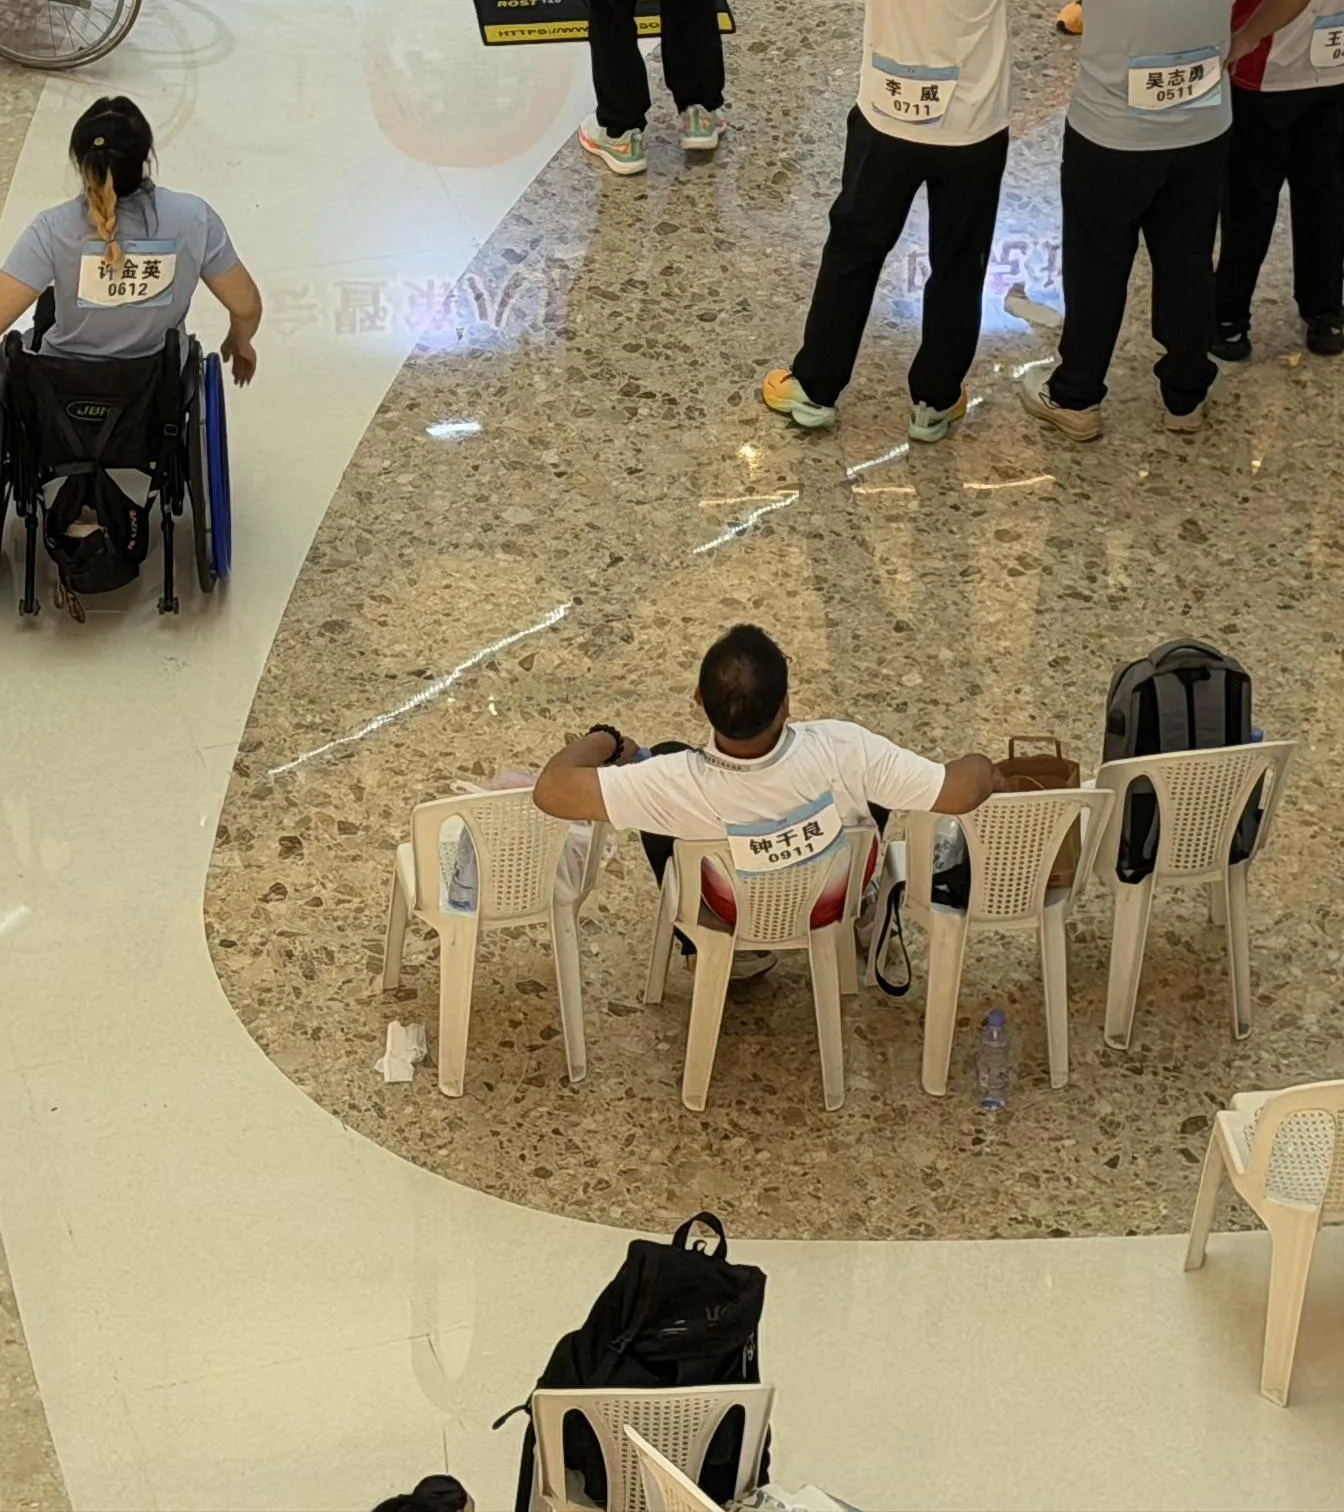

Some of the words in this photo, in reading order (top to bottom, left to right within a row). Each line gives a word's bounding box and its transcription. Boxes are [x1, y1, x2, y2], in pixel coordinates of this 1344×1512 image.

[497, 0, 538, 8] ROST
[1156, 84, 1193, 102] 0511
[893, 99, 930, 116] 0711
[97, 258, 163, 281] 许金英
[107, 282, 149, 297] 0612
[768, 842, 814, 863] 0911
